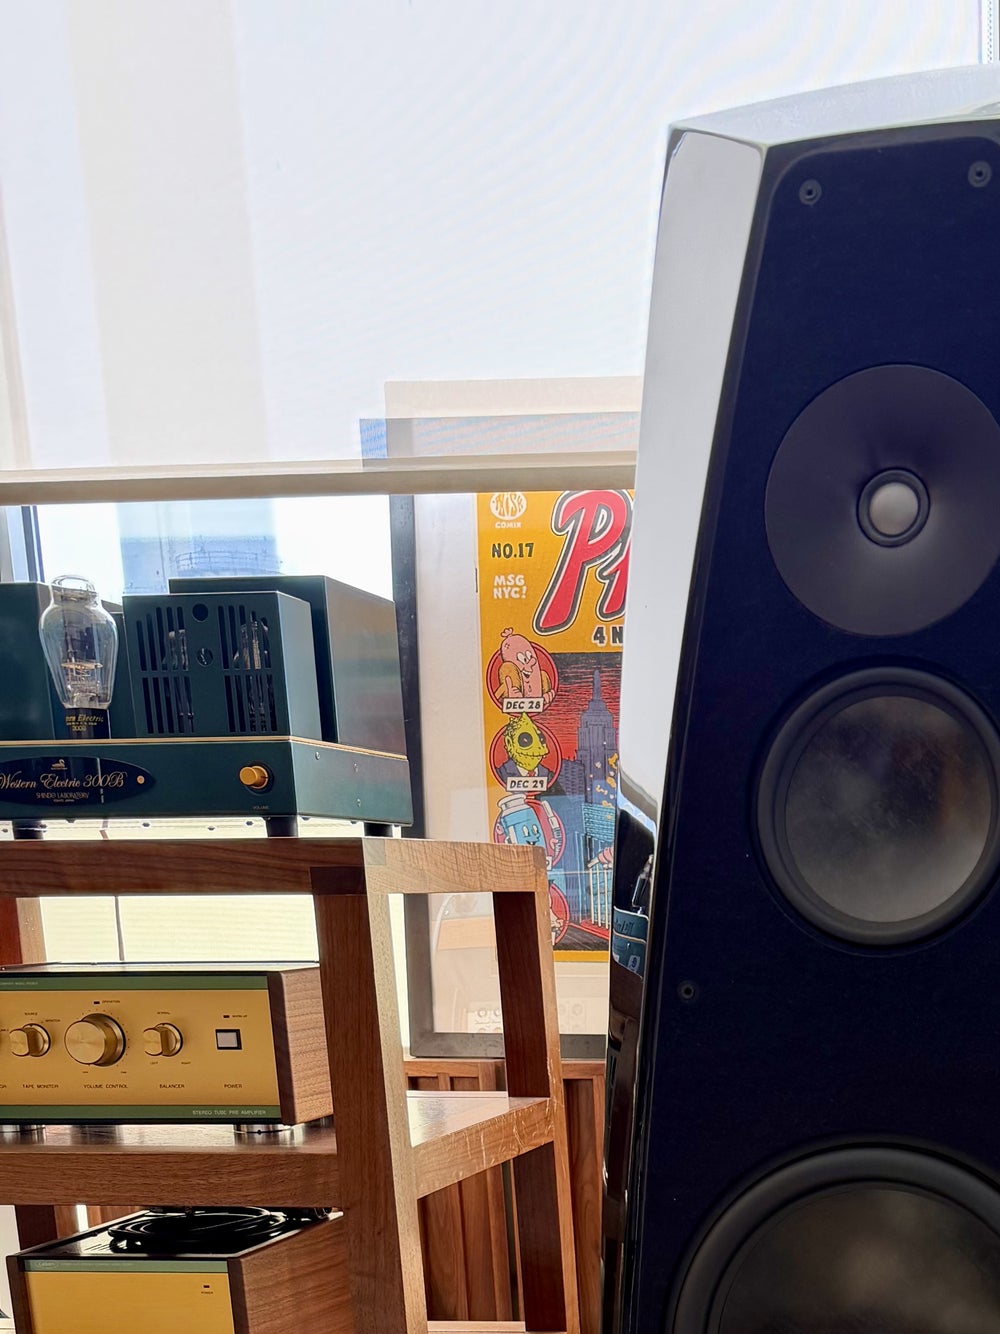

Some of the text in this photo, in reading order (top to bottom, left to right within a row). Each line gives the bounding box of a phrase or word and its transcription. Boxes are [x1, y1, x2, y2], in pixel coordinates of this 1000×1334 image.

[491, 542, 534, 559] NO.17
[494, 574, 525, 587] MSG
[493, 586, 527, 599] NYC!
[593, 626, 606, 644] 4
[506, 701, 525, 710] DEC
[0, 771, 128, 789] Western Electric 300B
[510, 780, 544, 788] DEC 29
